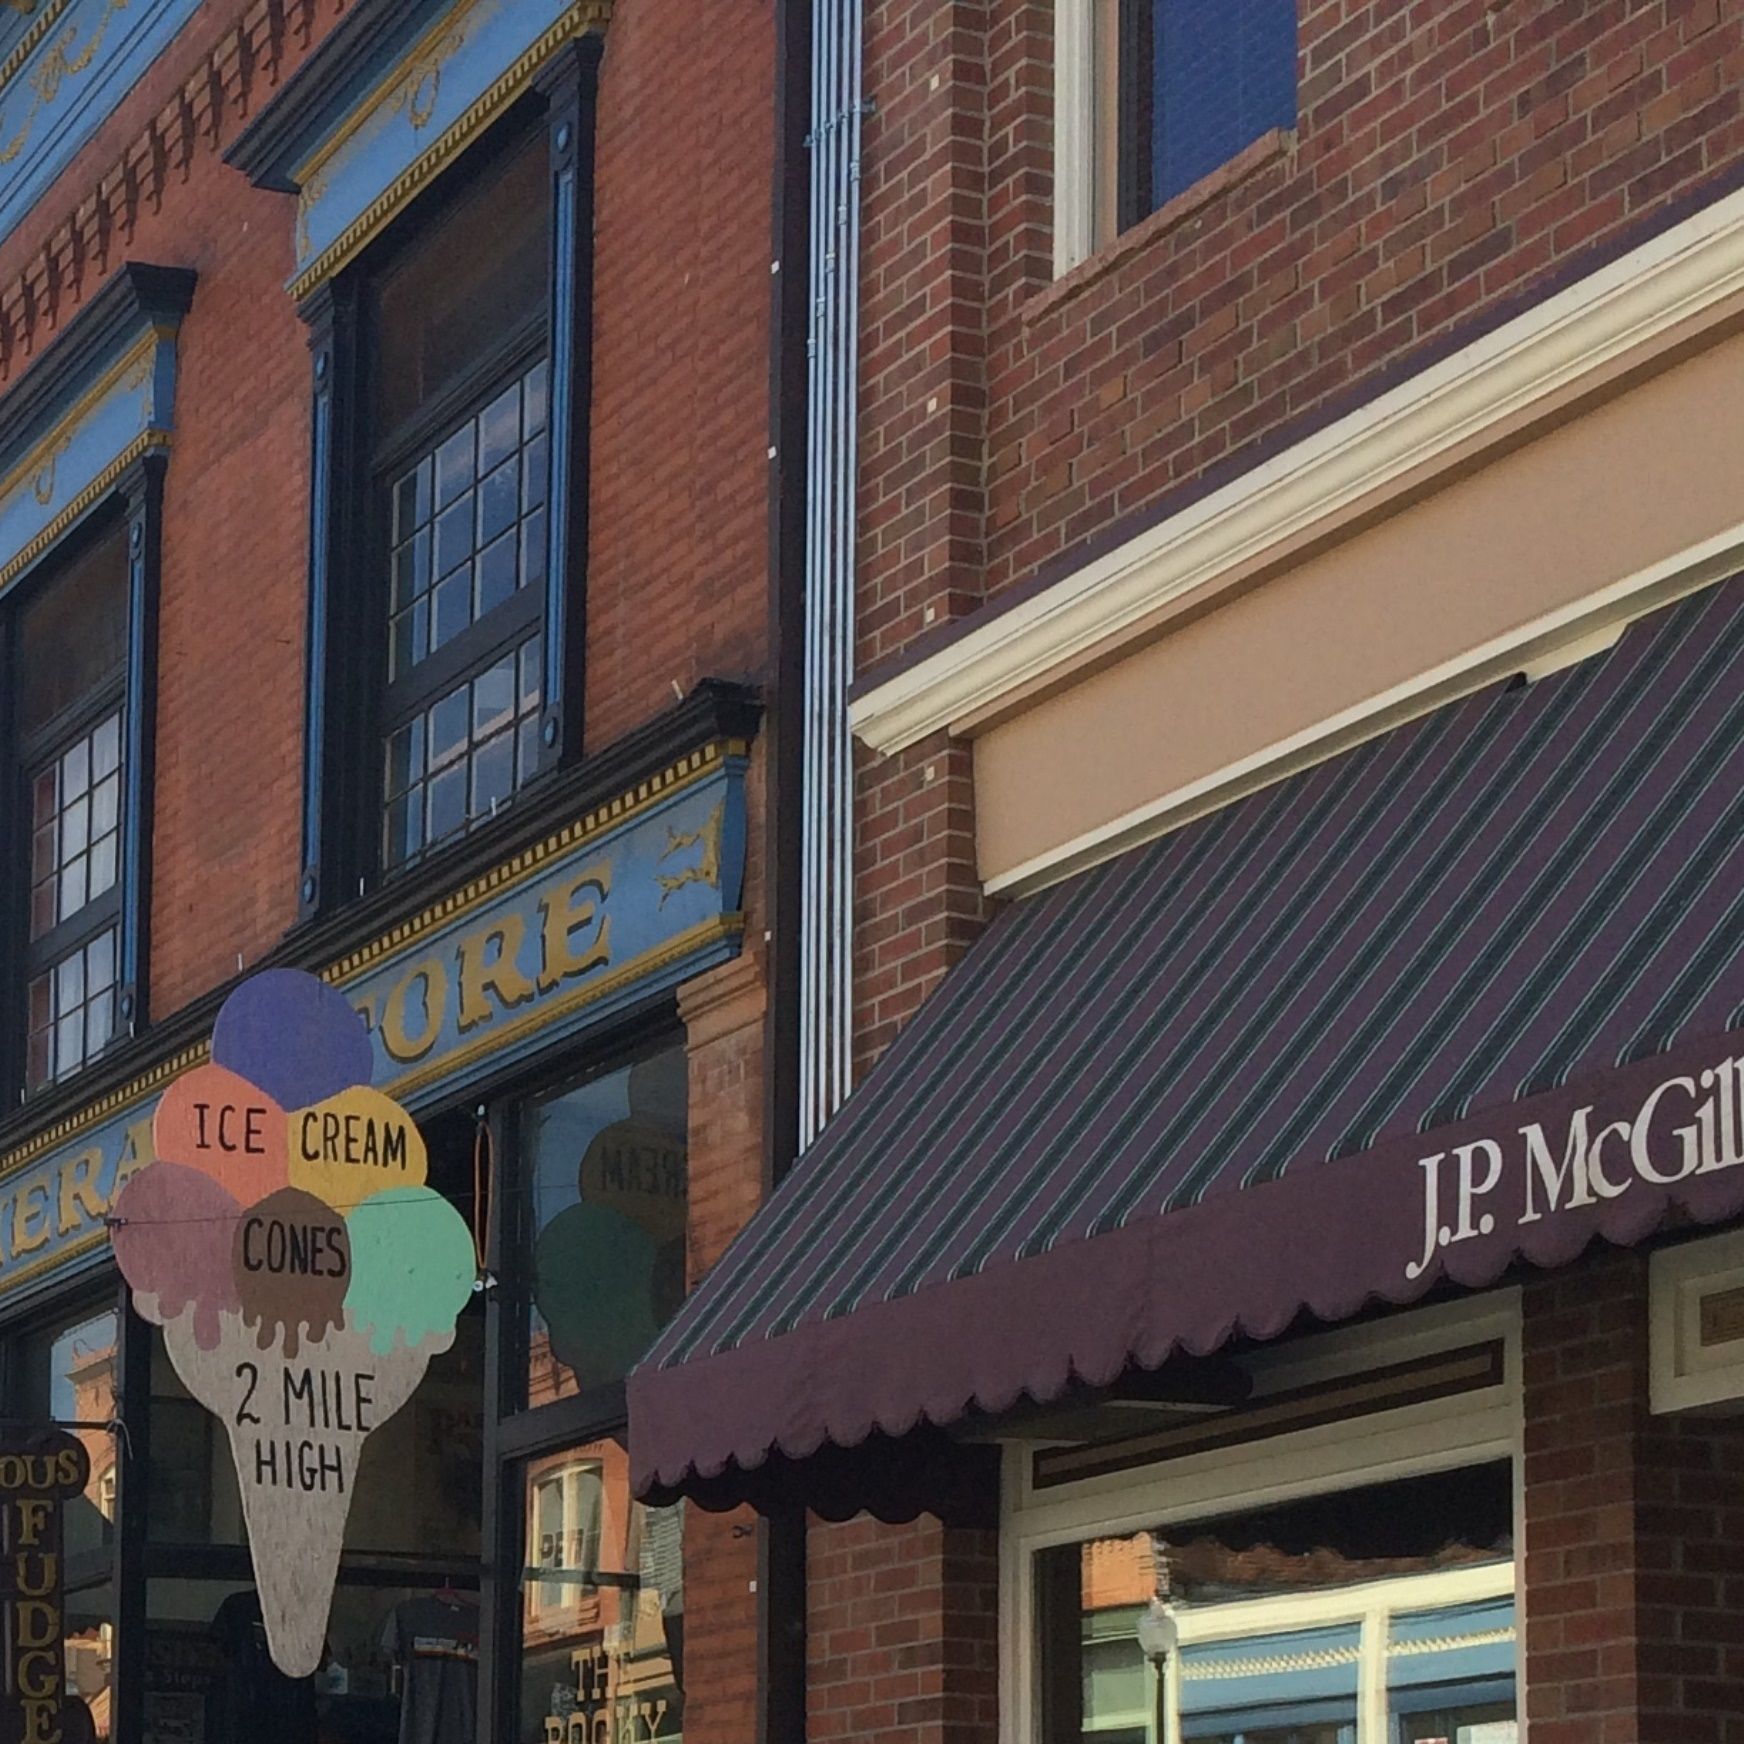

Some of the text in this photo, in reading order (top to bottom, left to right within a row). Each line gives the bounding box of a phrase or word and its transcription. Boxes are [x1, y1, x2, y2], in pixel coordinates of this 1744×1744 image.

[356, 858, 613, 1064] ORE
[193, 1104, 407, 1170] ICE CREAM
[1405, 1139, 1503, 1279] J.P.
[243, 1218, 346, 1278] CONES
[235, 1362, 261, 1427] 2
[284, 1367, 375, 1432] MILE
[255, 1439, 344, 1494] HIGH
